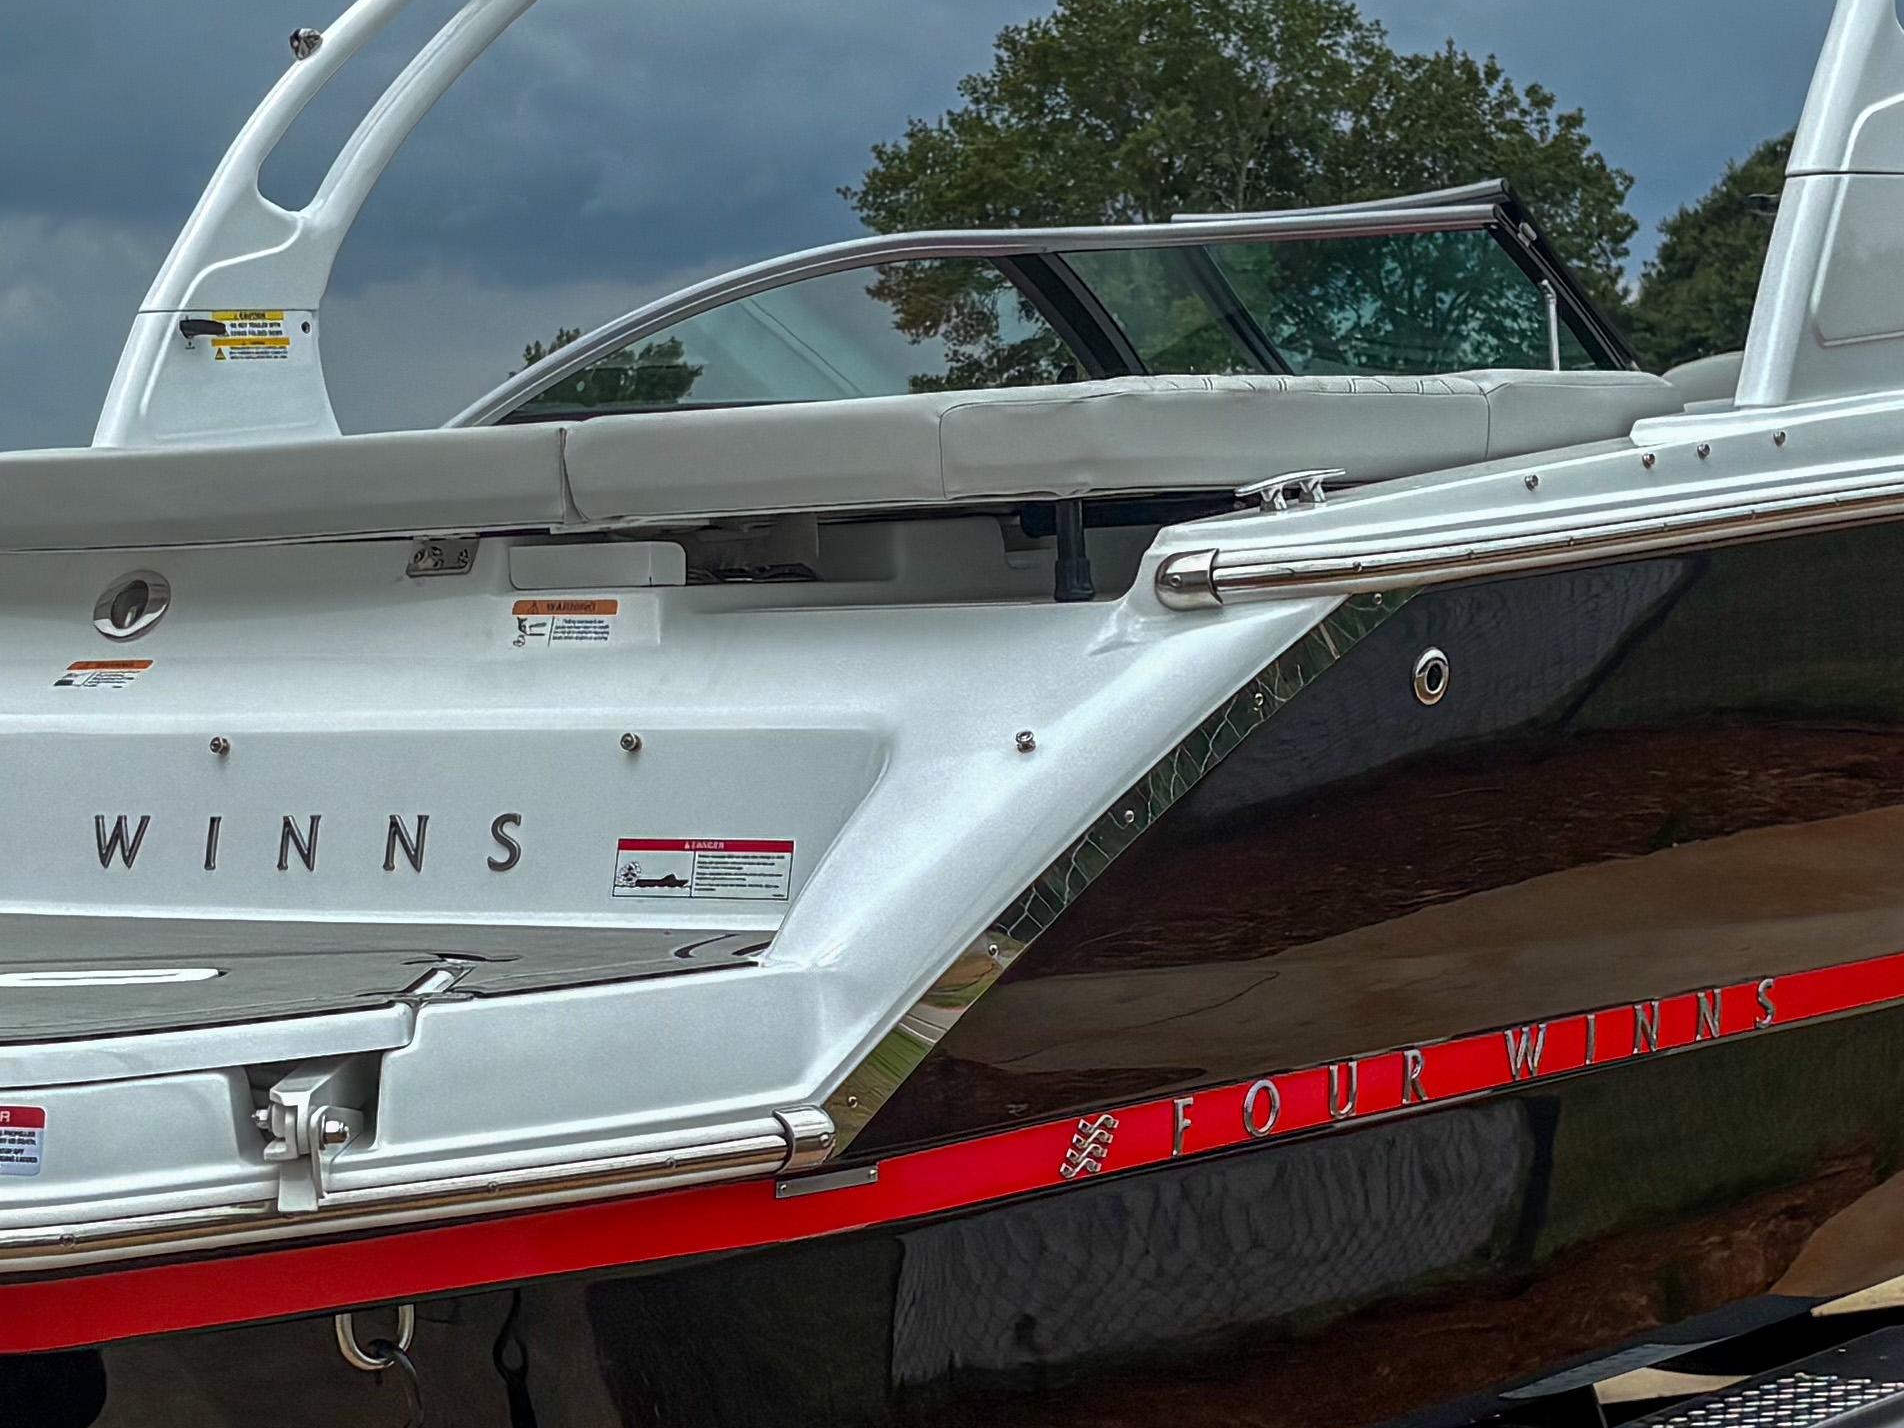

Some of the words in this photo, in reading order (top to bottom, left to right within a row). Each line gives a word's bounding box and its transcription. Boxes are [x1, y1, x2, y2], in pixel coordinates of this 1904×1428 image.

[96, 813, 523, 874] WINNS
[1172, 1048, 1429, 1157] FOUR
[1504, 978, 1776, 1081] WINNS
